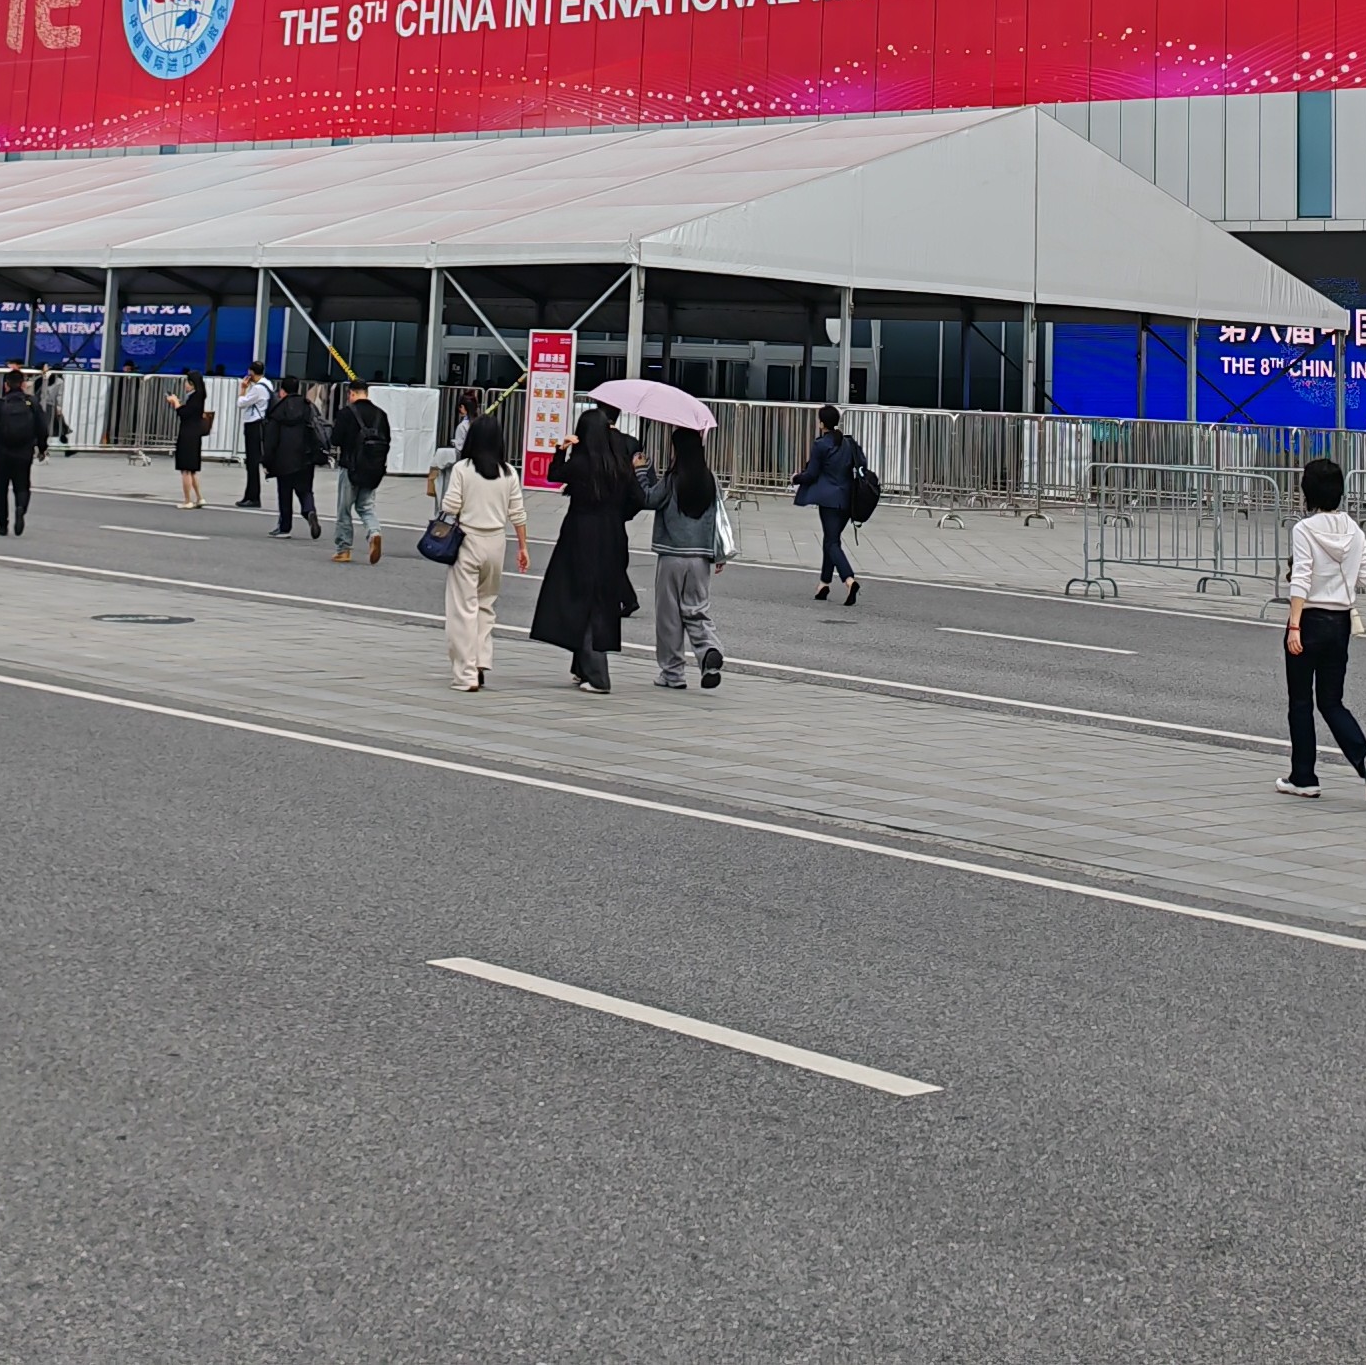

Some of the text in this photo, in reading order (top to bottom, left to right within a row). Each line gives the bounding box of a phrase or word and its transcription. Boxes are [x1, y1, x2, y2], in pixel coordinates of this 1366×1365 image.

[280, 6, 339, 45] THE
[347, 0, 388, 42] 8TH
[1220, 356, 1256, 375] THE
[1260, 357, 1285, 376] 8TH
